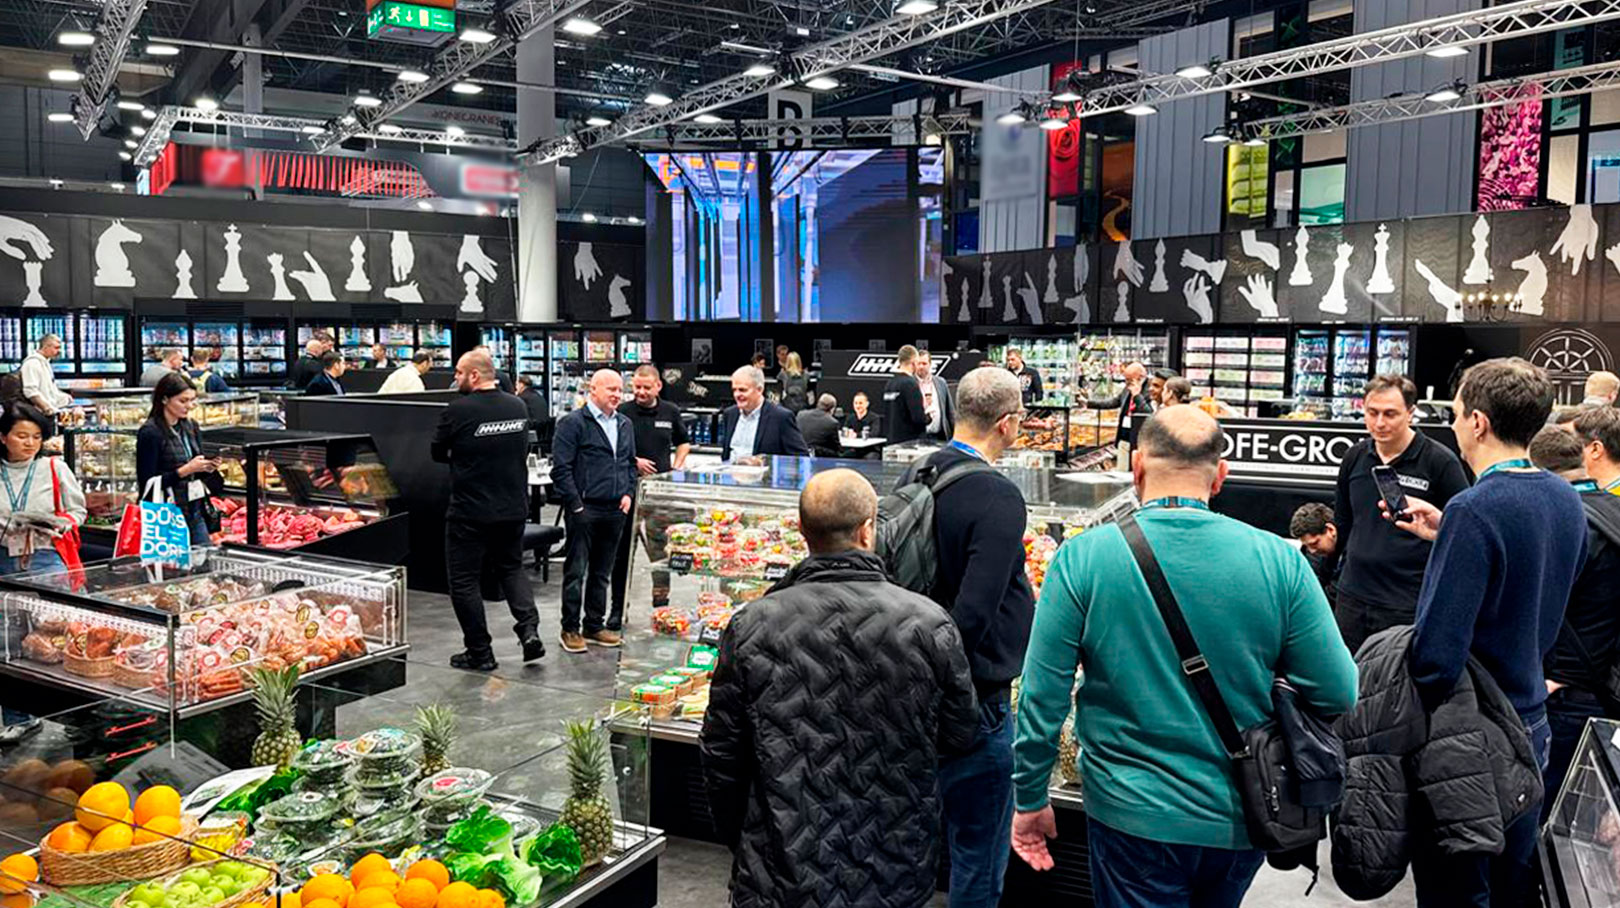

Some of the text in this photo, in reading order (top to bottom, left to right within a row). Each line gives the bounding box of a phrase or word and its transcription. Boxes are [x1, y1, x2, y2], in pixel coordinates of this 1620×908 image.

[853, 356, 945, 374] HitLE
[1219, 432, 1364, 463] FE-GRO
[142, 525, 167, 541] EL
